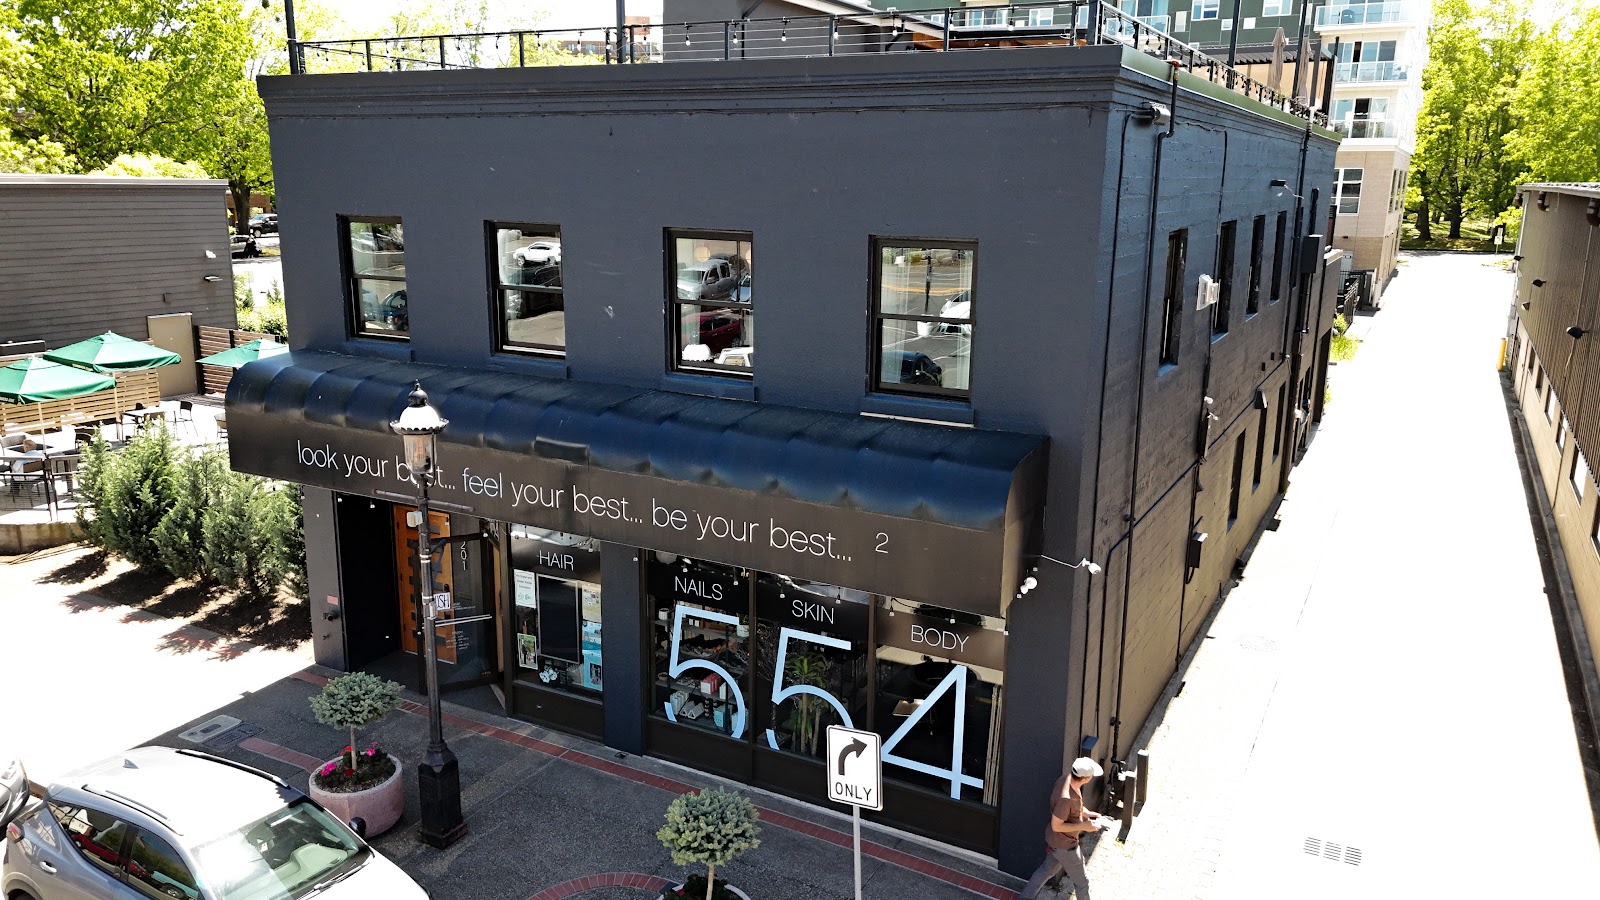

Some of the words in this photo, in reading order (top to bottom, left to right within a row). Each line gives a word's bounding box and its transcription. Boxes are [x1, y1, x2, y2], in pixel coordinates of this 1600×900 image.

[297, 439, 339, 470] look
[343, 453, 389, 478] your
[395, 455, 456, 490] bst...
[462, 467, 503, 499] feel
[511, 481, 565, 508] your
[573, 484, 643, 523] best...
[652, 498, 688, 531] be
[696, 513, 760, 543] your
[769, 518, 852, 562] best...
[875, 532, 889, 554] 2
[538, 549, 575, 571] HAIR
[674, 575, 723, 601] NAILS
[434, 594, 450, 609] USH
[791, 600, 835, 625] SKIN
[910, 624, 970, 653] BODY
[835, 781, 872, 802] ONLY
